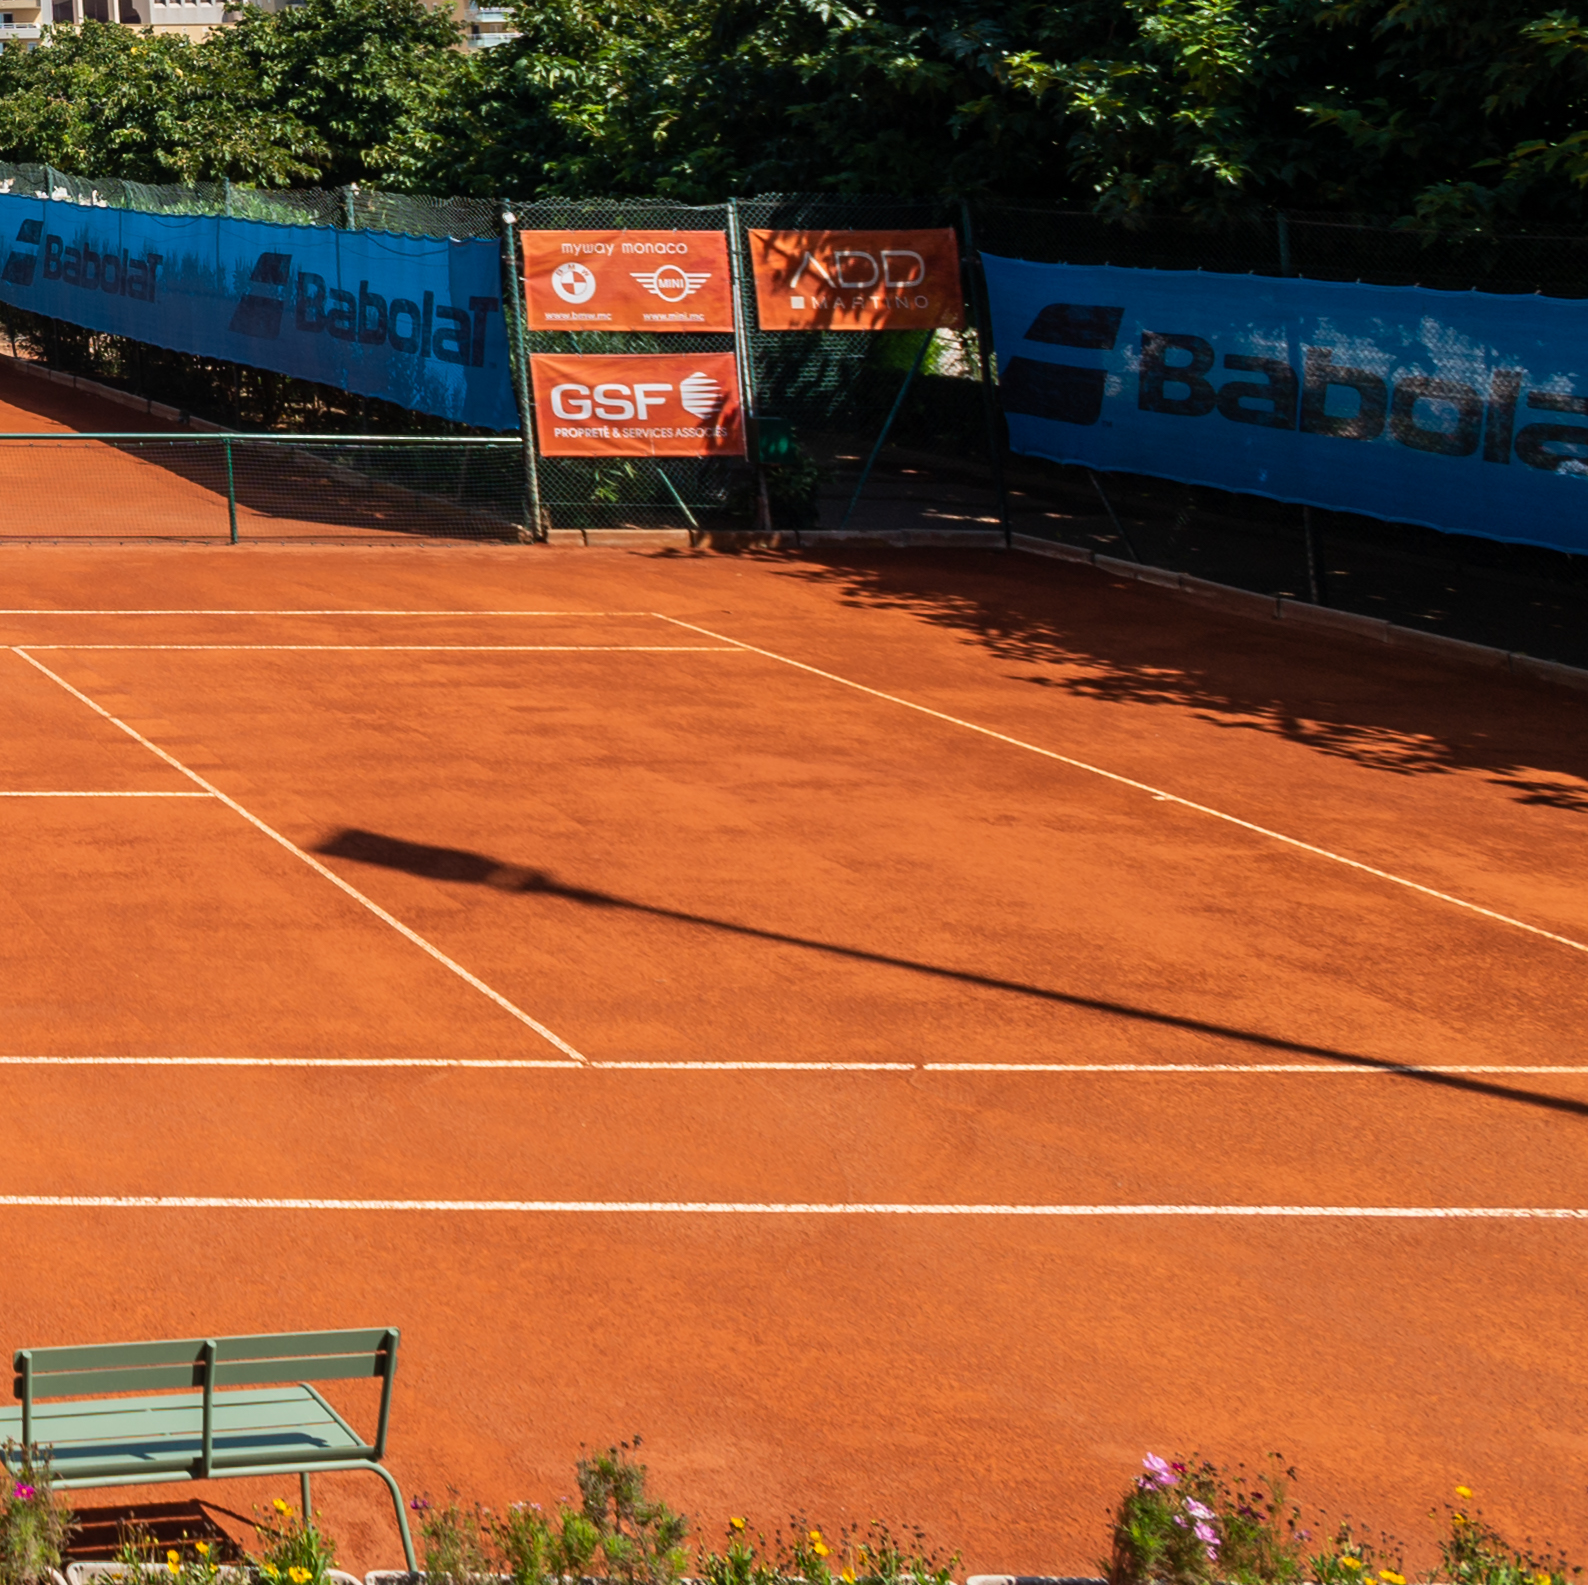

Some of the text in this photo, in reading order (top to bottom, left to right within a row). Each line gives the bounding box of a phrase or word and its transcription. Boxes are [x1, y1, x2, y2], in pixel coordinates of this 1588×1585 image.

[560, 242, 688, 256] myway monaco
[658, 278, 684, 289] MINI
[811, 295, 929, 310] MARTINO
[544, 311, 705, 322] www.bmw.mc www.mini.mc
[551, 383, 673, 420] GSF
[554, 425, 728, 439] PROPRETÉ & SERVICES ASSOCIÉS
